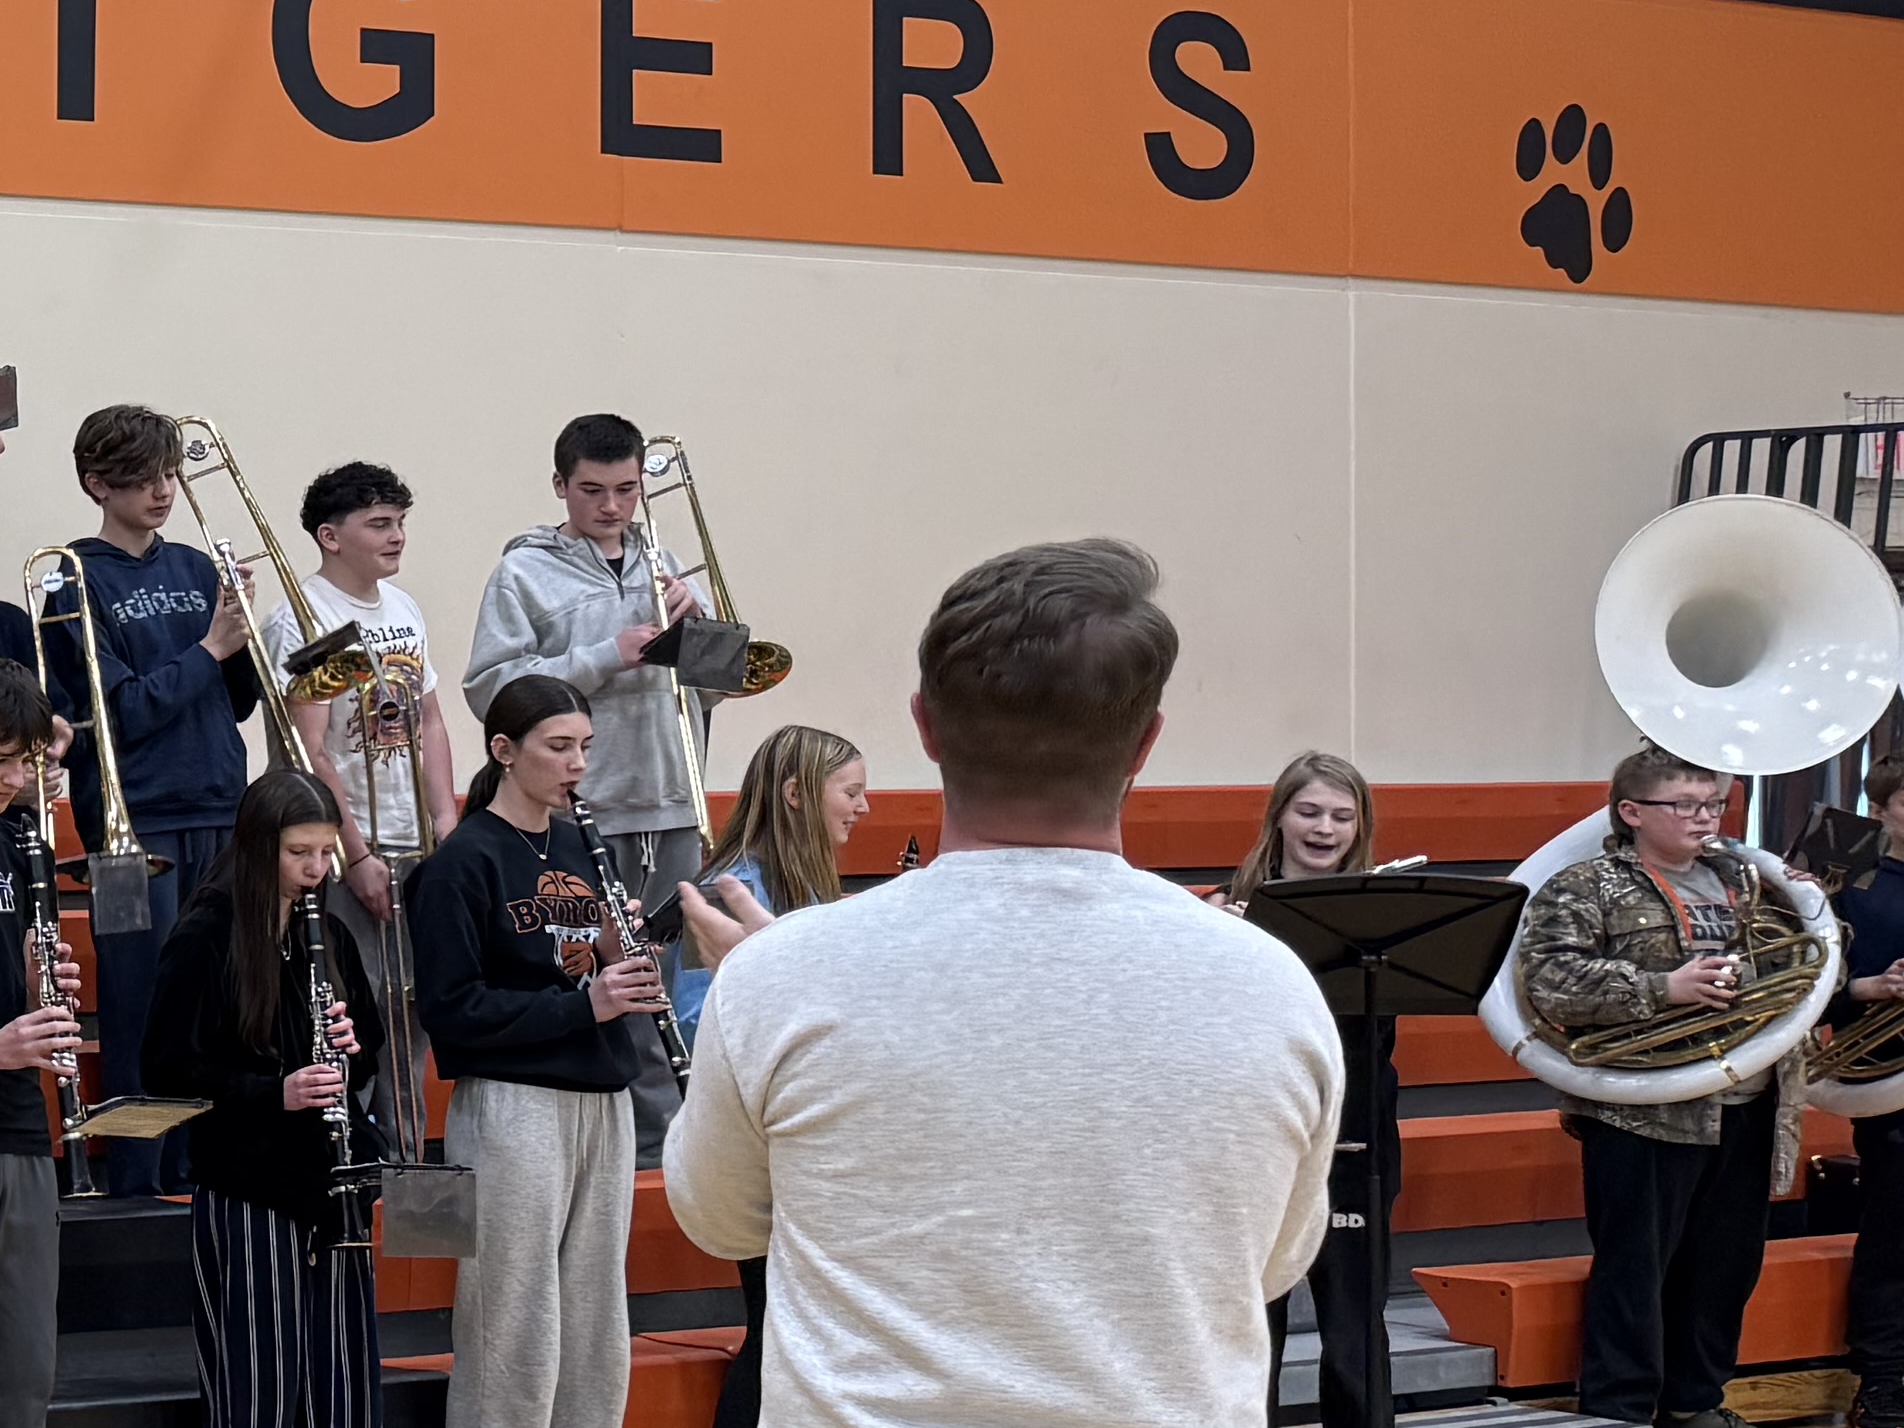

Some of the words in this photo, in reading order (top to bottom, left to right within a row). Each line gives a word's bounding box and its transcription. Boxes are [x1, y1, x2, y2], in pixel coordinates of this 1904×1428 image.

[112, 585, 208, 626] adidas
[362, 625, 416, 644] blime
[506, 895, 601, 933] BYRO
